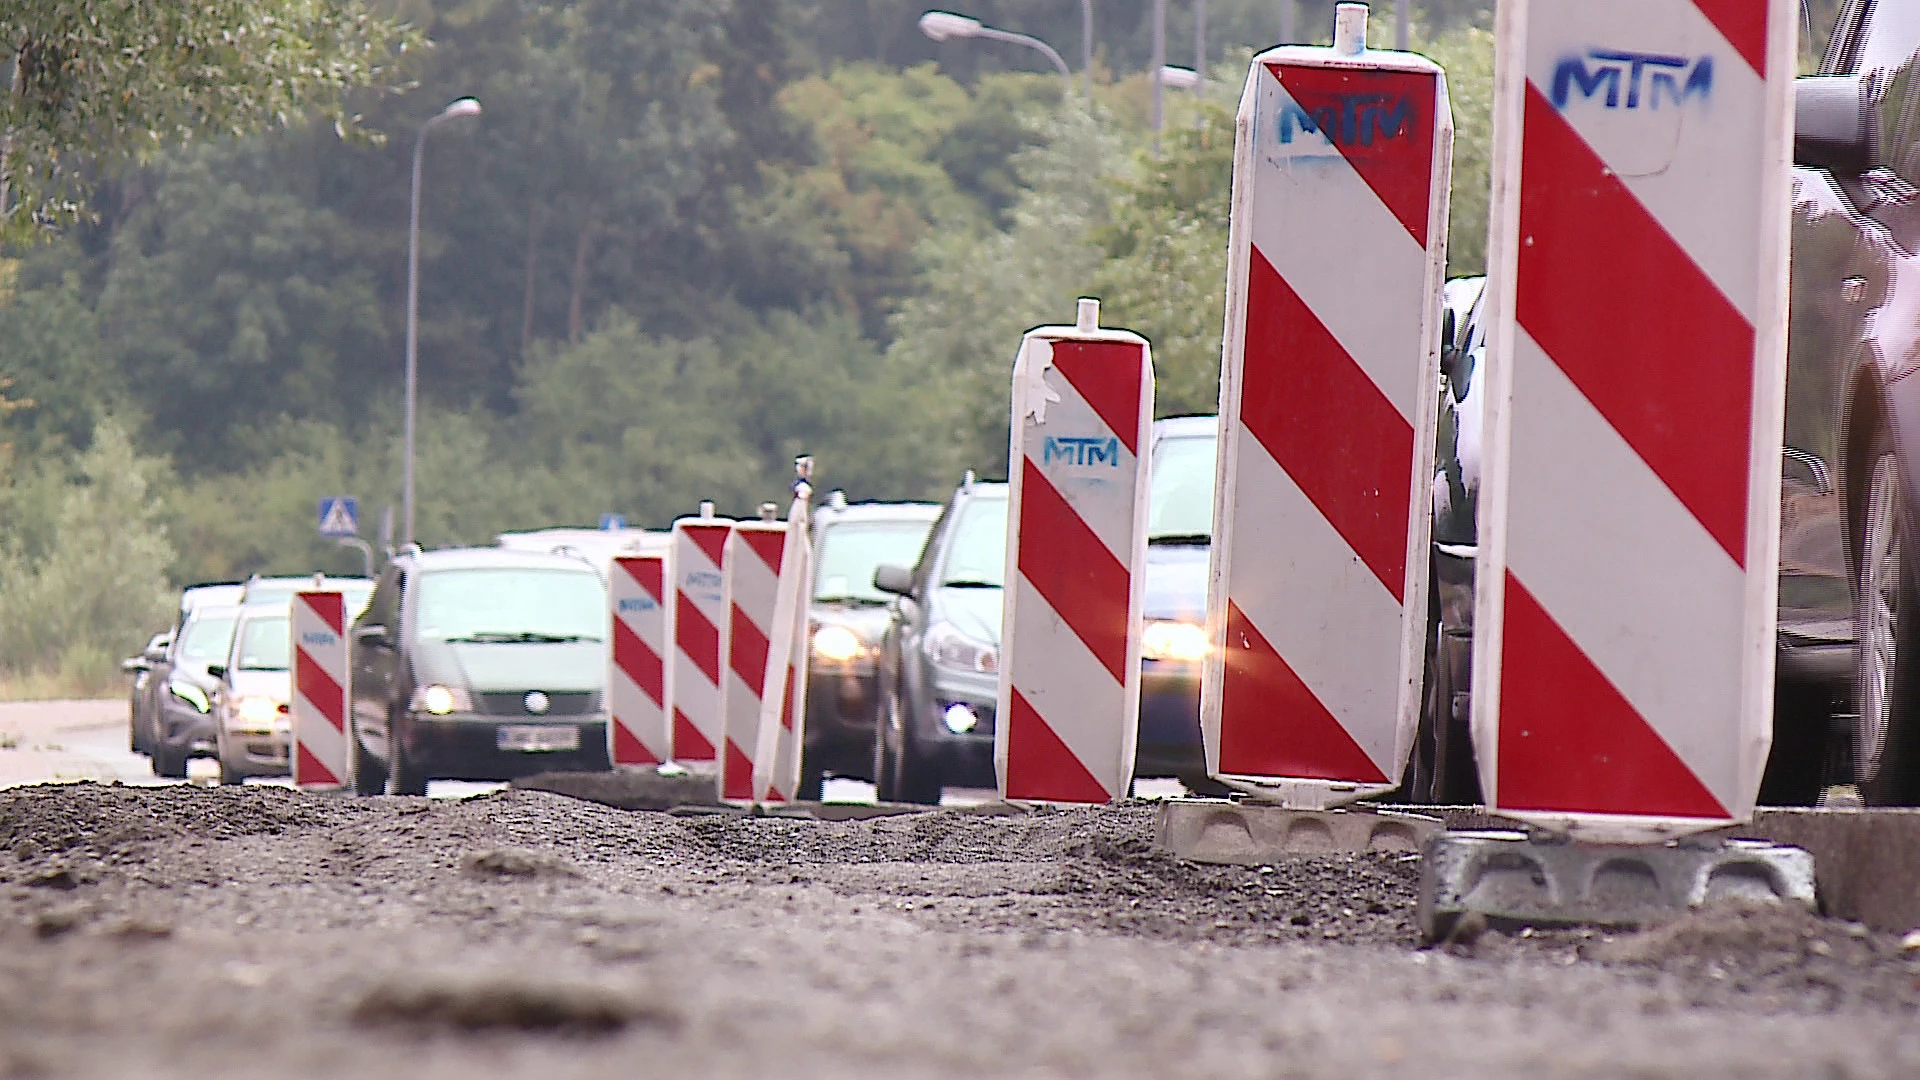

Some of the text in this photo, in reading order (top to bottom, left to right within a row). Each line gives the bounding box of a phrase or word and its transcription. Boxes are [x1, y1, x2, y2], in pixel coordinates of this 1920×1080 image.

[1551, 48, 1713, 109] MTM
[1279, 94, 1417, 146] MTM
[1044, 436, 1118, 467] MTM
